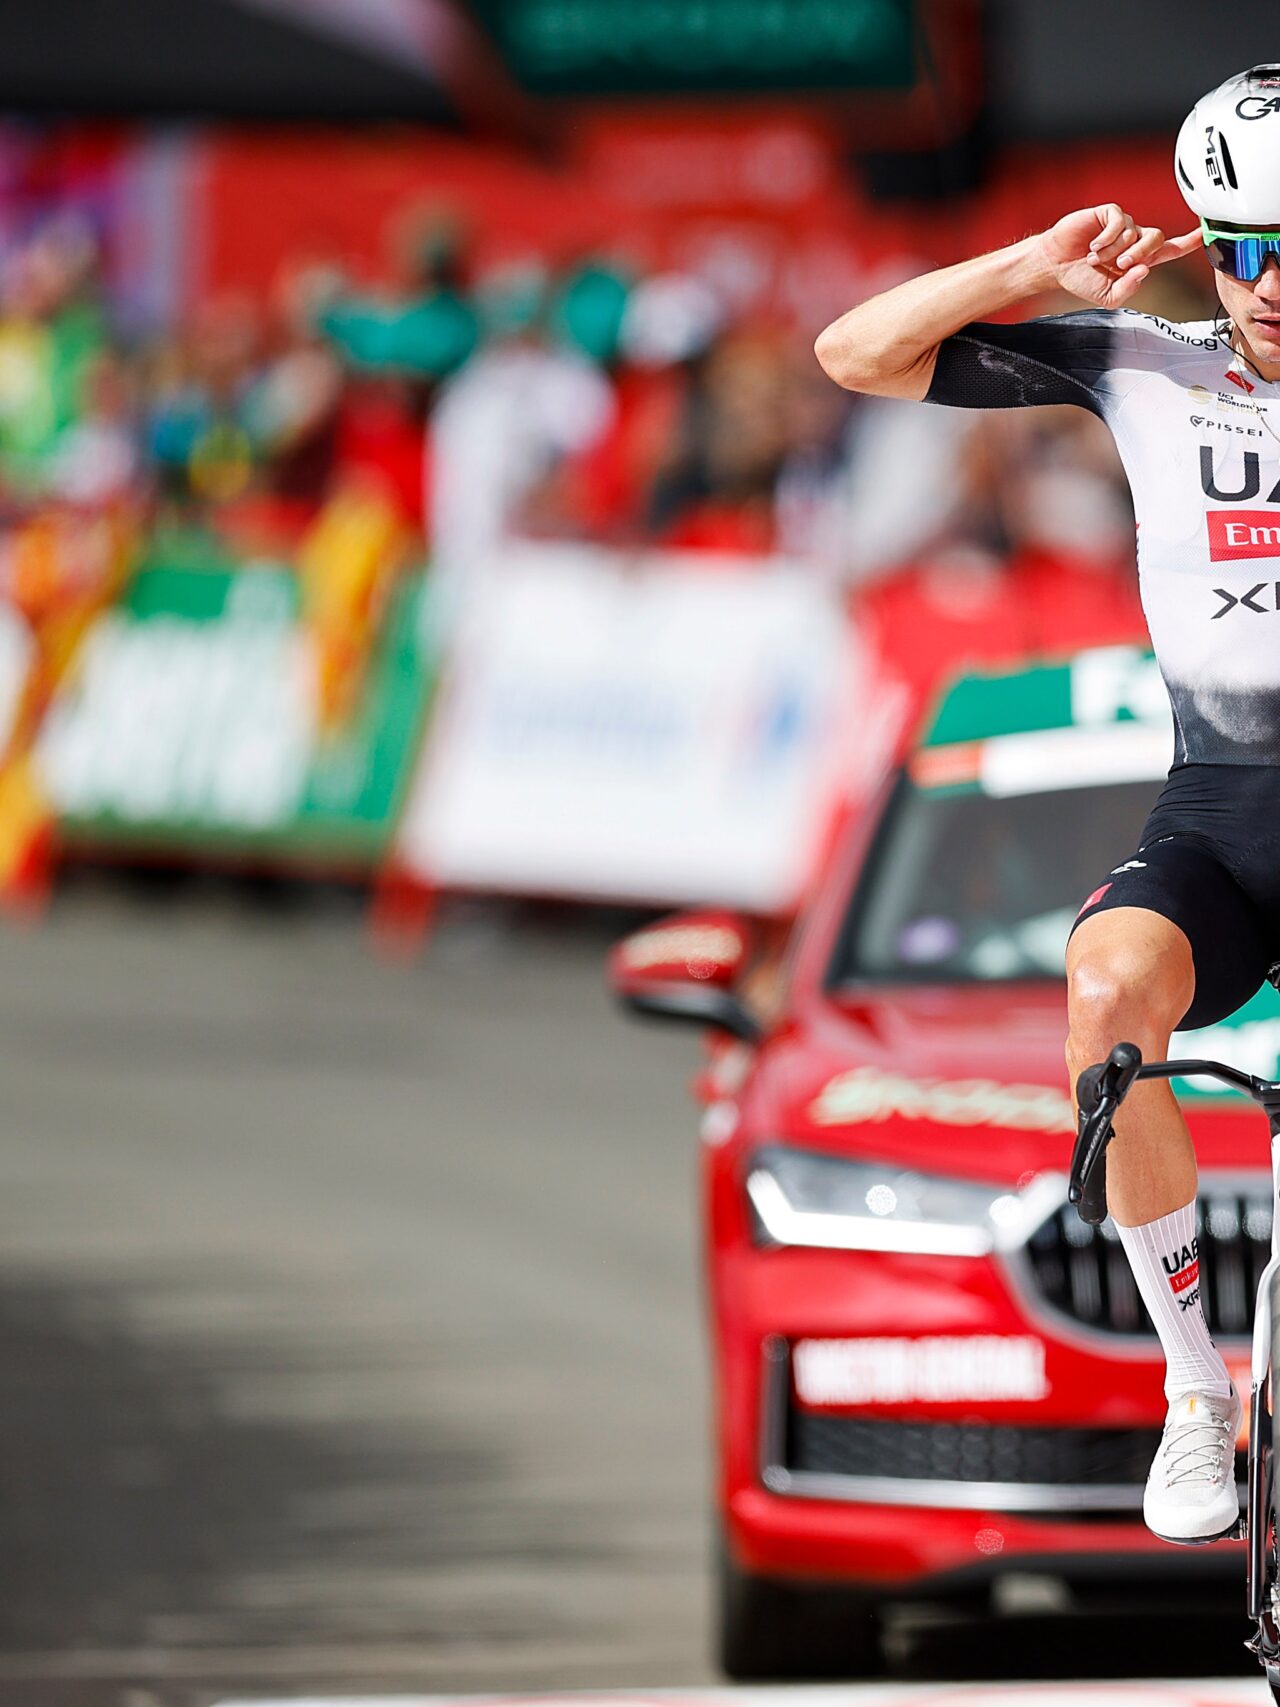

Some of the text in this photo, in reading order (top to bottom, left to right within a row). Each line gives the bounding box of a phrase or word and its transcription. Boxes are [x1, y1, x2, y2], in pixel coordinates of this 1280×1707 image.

[1204, 126, 1226, 191] MET
[1144, 315, 1218, 350] Analog
[1217, 391, 1234, 401] UCI
[1206, 420, 1263, 437] PISSEI
